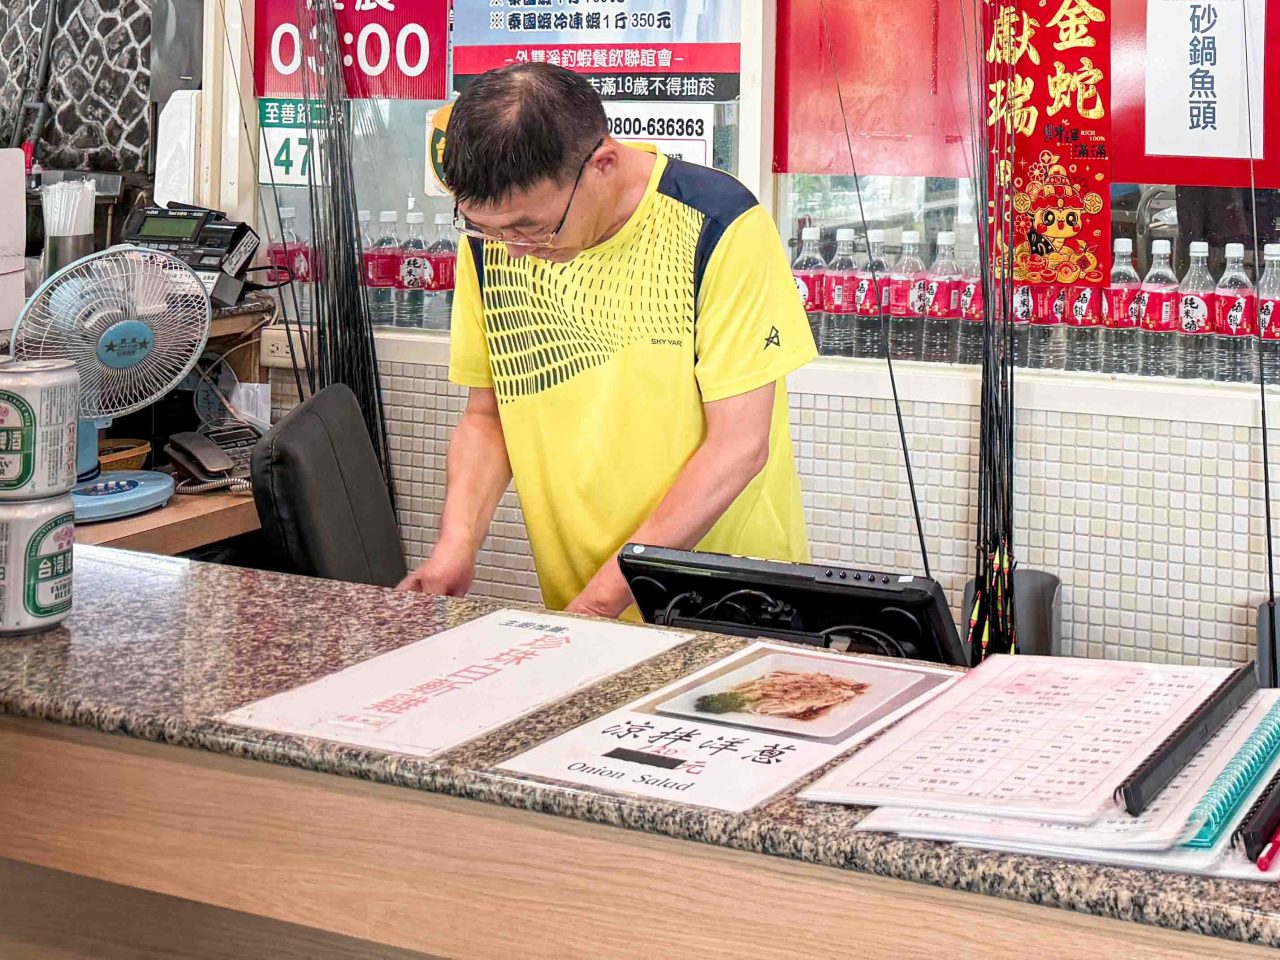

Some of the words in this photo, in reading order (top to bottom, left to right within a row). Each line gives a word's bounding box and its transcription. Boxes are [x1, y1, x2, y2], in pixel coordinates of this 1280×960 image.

[1189, 4, 1218, 131] 砂鍋魚頭
[567, 761, 625, 781] Onion
[632, 772, 697, 792] Salad
